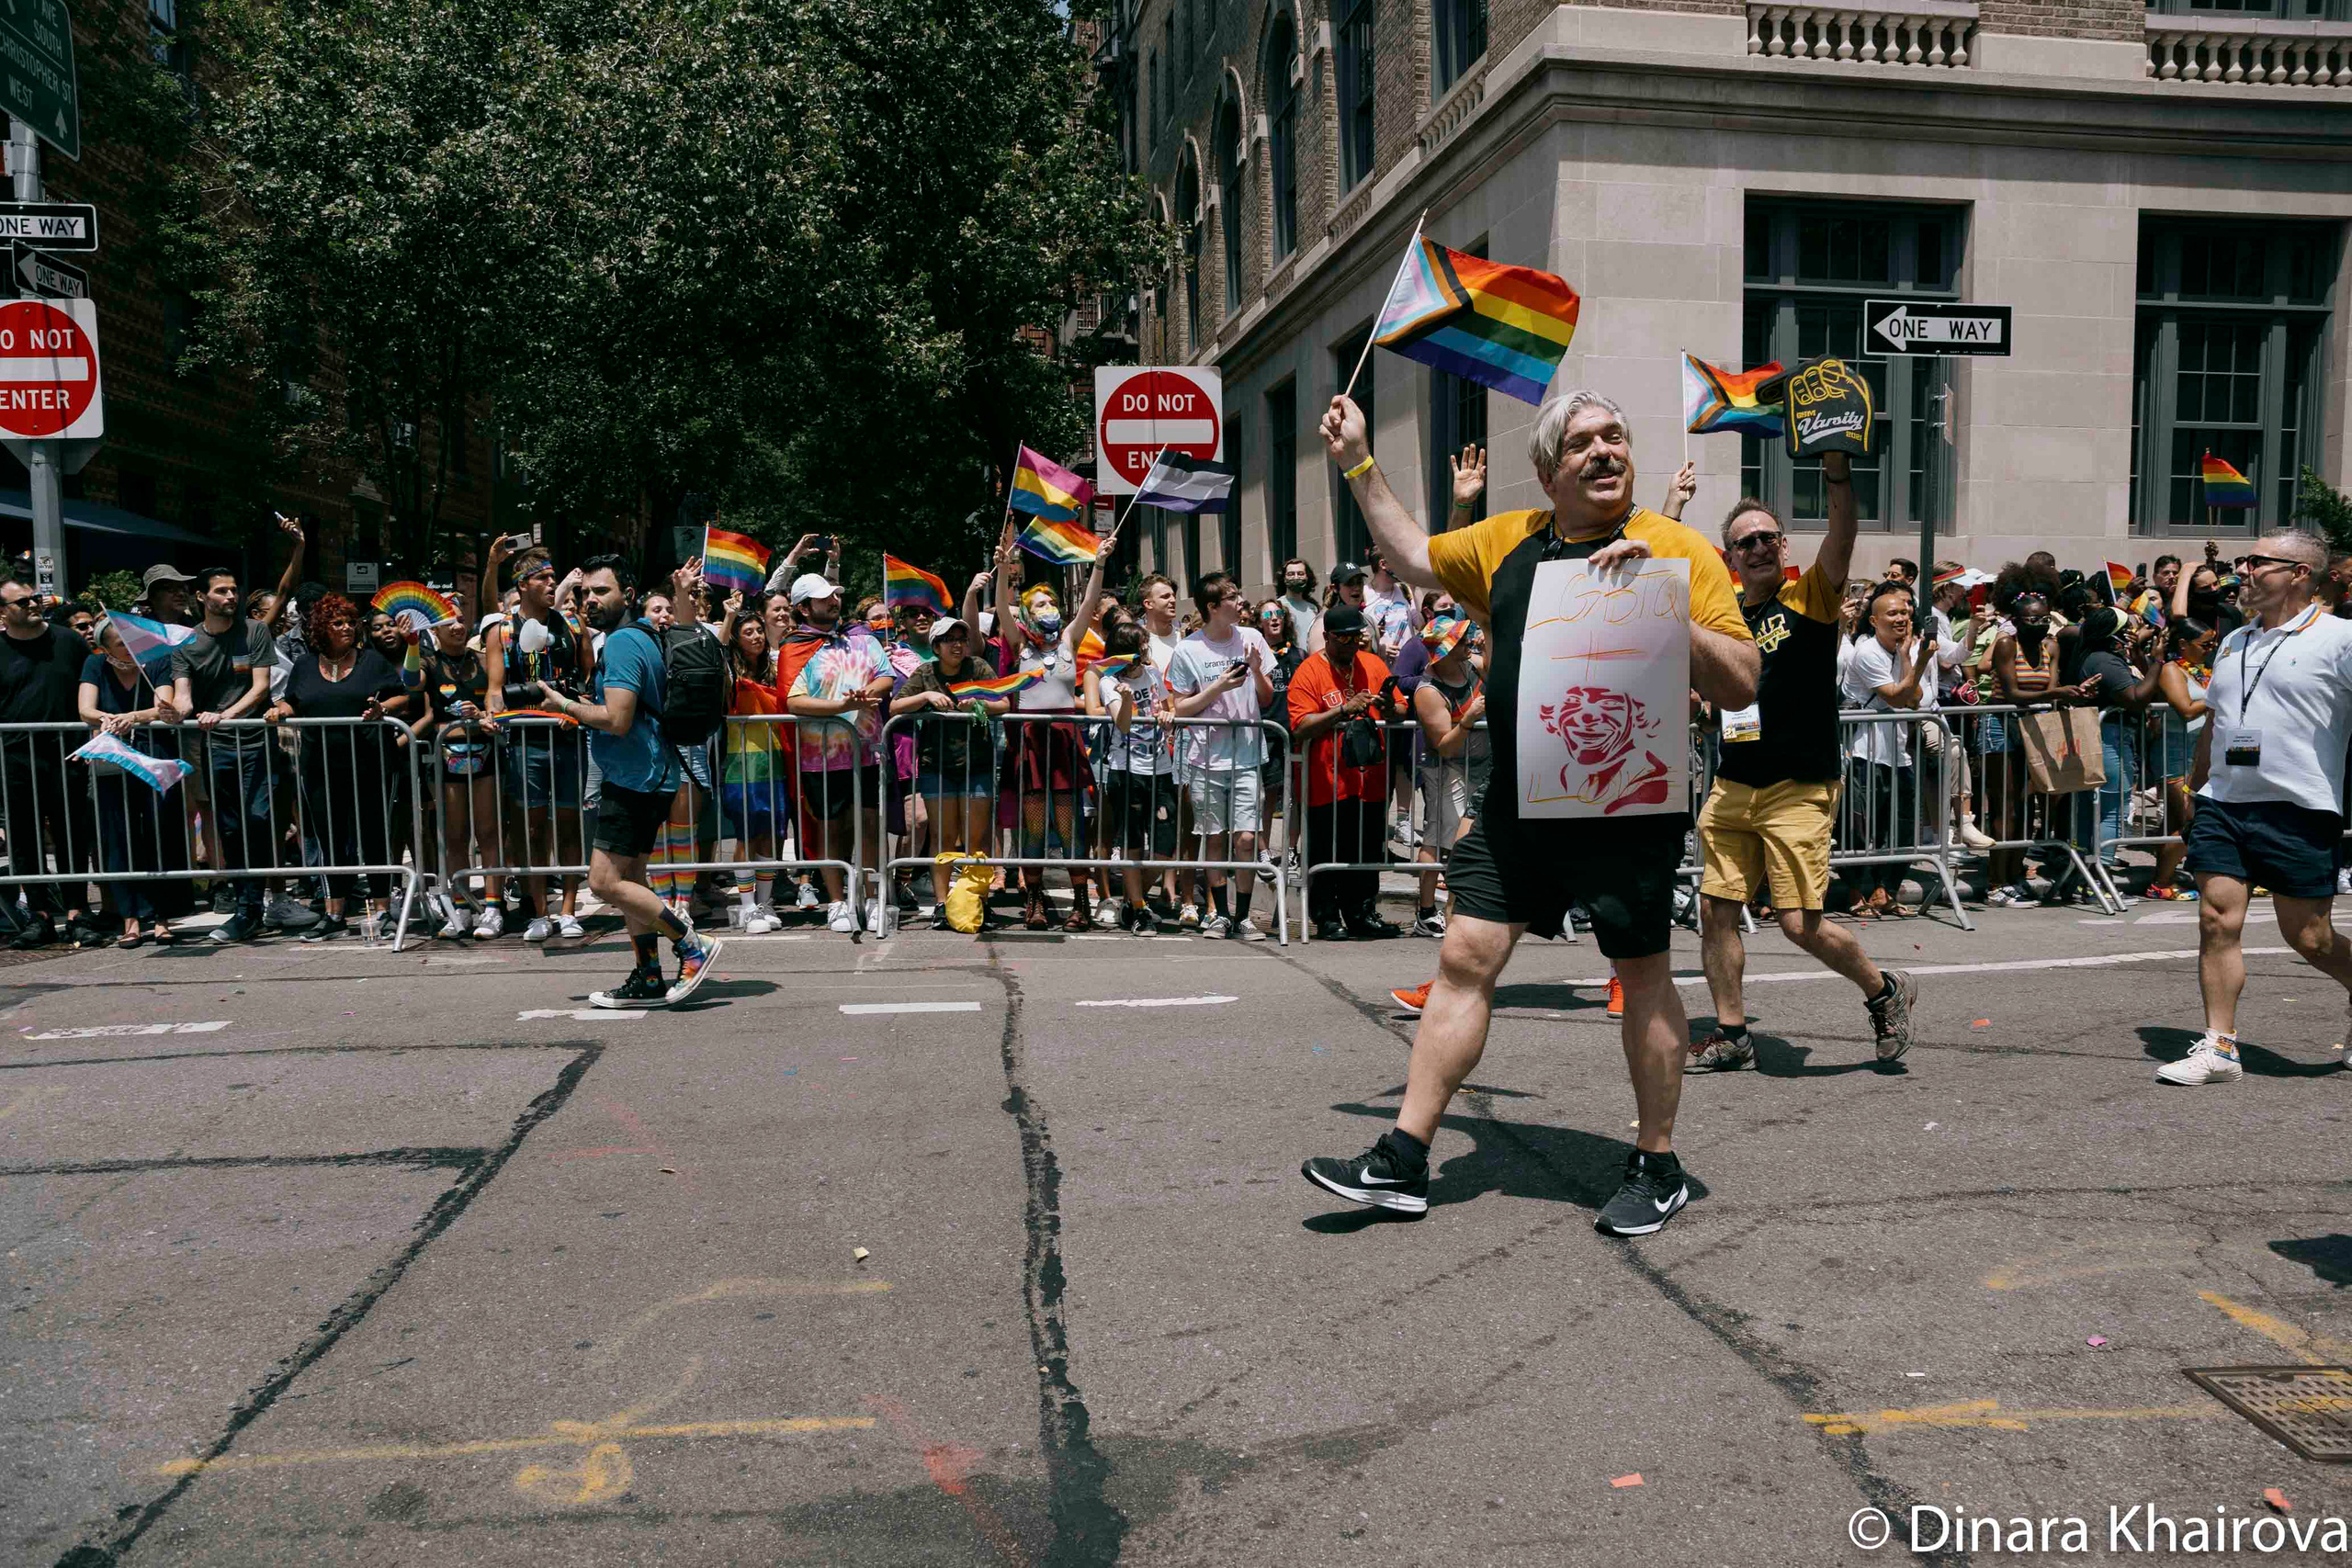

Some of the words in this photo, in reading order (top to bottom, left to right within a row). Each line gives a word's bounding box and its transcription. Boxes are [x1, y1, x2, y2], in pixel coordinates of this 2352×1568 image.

[33, 18, 62, 60] SOUTH
[8, 73, 34, 111] WEST
[61, 79, 72, 106] ST
[39, 219, 79, 236] WAY
[36, 265, 56, 288] ONE
[58, 274, 80, 297] WAY
[0, 329, 15, 350] O
[29, 329, 74, 349] NOT
[1889, 319, 1928, 339] ONE
[1949, 321, 1992, 341] WAY
[0, 389, 71, 410] ENTER
[1123, 394, 1148, 412] DO
[1158, 394, 1195, 412] NOT
[1797, 411, 1865, 436] Varsity
[1204, 660, 1225, 669] trans
